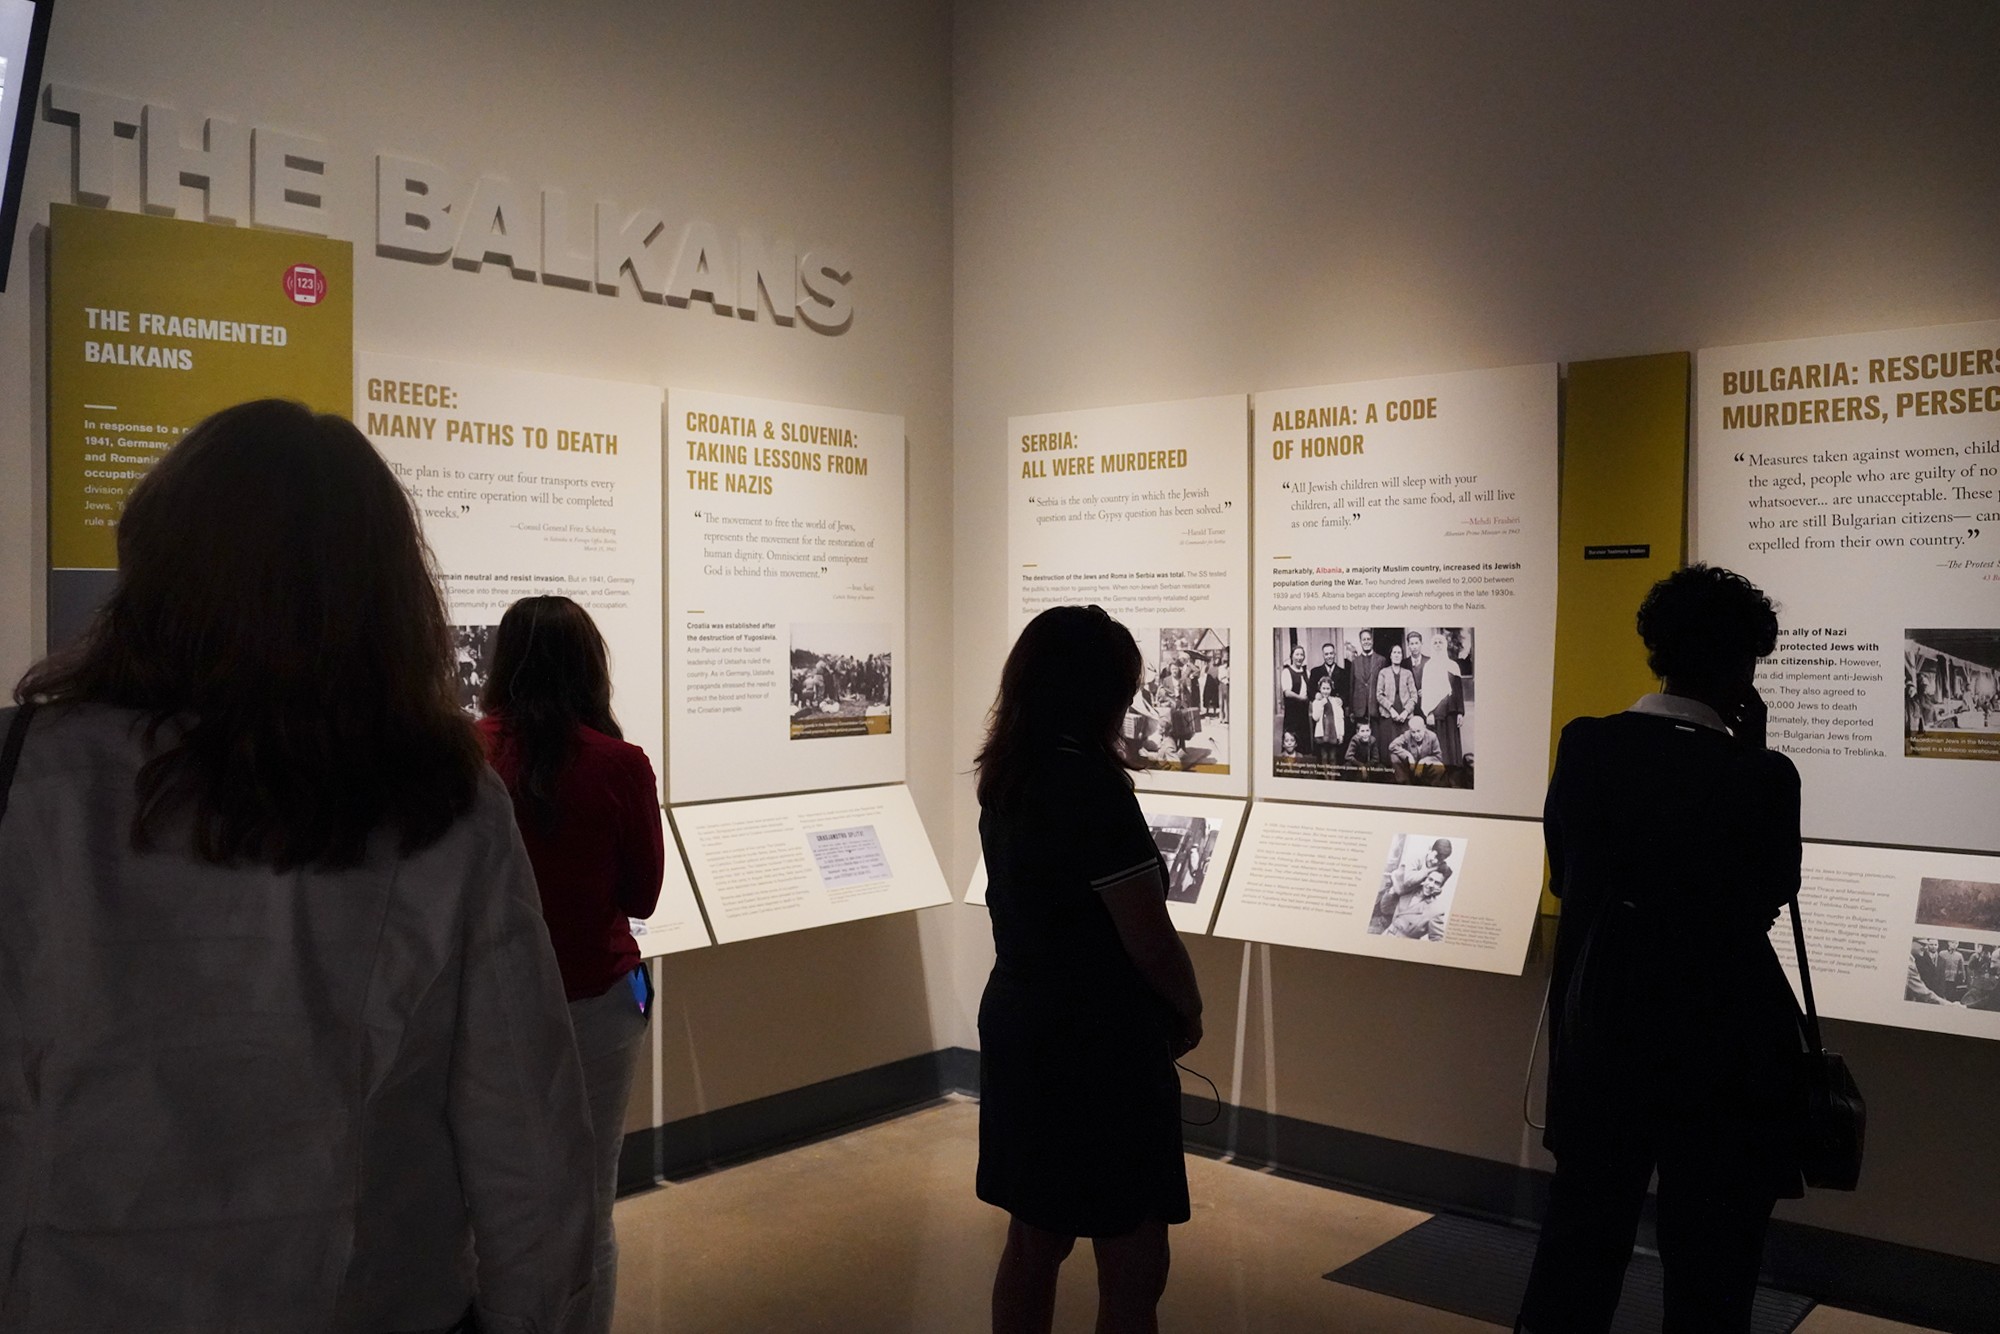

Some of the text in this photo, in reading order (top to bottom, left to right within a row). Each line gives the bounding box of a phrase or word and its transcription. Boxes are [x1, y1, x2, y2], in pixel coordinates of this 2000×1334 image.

[42, 83, 853, 336] THE BALKANS
[297, 278, 314, 290] 123
[85, 308, 288, 346] THE FRAGMENTED
[85, 342, 193, 370] BALKANS
[1723, 363, 1858, 395] BULGARIA:
[368, 379, 458, 408] GREECE:
[1272, 398, 1437, 431] ALBANIA: A CODE
[1723, 396, 1888, 429] MURDERERS,
[84, 420, 96, 429] In
[100, 423, 154, 432] response
[156, 425, 169, 434] to
[368, 413, 618, 455] MANY PATHS TO DEATH
[686, 412, 858, 448] CROATIA & SLOVENIA:
[85, 436, 114, 447] 1941,
[1022, 432, 1078, 453] SERBIA:
[1273, 435, 1364, 460] OF HONOR
[84, 453, 106, 462] and
[686, 441, 868, 475] TAKING LESSONS FROM
[1022, 449, 1187, 479] ALL WERE MURDERED
[1813, 450, 1848, 463] taken
[1853, 448, 1900, 463] against
[1905, 447, 1959, 458] women,
[416, 465, 440, 480] plan
[443, 467, 452, 478] is
[454, 470, 466, 479] to
[468, 472, 495, 484] carry
[498, 474, 514, 482] out
[517, 472, 538, 484] four
[540, 476, 588, 488] transports
[591, 481, 616, 491] every
[686, 470, 773, 495] THE NAZIS
[1307, 481, 1338, 495] Jewish
[1340, 479, 1378, 490] children
[1381, 476, 1400, 488] will
[1402, 476, 1427, 490] sleep
[1429, 474, 1452, 485] with
[1454, 475, 1478, 488] your
[1749, 464, 1998, 490] the aged, people who are guilty of no
[426, 486, 614, 509] the entire operation will be completed
[1060, 497, 1067, 506] is
[1068, 496, 1080, 505] the
[1082, 494, 1100, 506] only
[1102, 495, 1130, 504] country
[1132, 492, 1140, 502] in
[1141, 490, 1166, 501] which
[1168, 489, 1181, 500] the
[1182, 488, 1210, 501] Jewish
[1291, 489, 1516, 511] children, all will eat the same food, all will live
[1832, 496, 1853, 505] are
[1857, 488, 1947, 505] unacceptable.
[1952, 486, 1993, 500] These
[722, 517, 762, 526] movement
[775, 516, 790, 528] free
[791, 518, 804, 528] the
[805, 519, 826, 530] world
[827, 520, 836, 531] of
[836, 520, 856, 532] Jews,
[1036, 514, 1066, 526] question
[1068, 511, 1082, 521] and
[1084, 510, 1096, 520] the
[1098, 509, 1123, 522] Gypsy
[1124, 509, 1157, 521] question
[1159, 506, 1173, 516] has
[1174, 506, 1194, 516] been
[1748, 517, 1775, 529] who
[1779, 520, 1798, 528] are
[1803, 514, 1827, 527] still
[1832, 513, 1896, 528] Bulgarian
[1748, 537, 1800, 553] expelled
[1805, 536, 1835, 549] from
[1840, 535, 1872, 548] their
[1876, 538, 1904, 547] own
[1792, 628, 1809, 638] ally
[1812, 628, 1822, 636] of
[1825, 628, 1847, 636] Nazi
[1780, 643, 1879, 652] protected Jews with
[1780, 657, 1837, 667] citizenship.
[1840, 658, 1881, 667] However,
